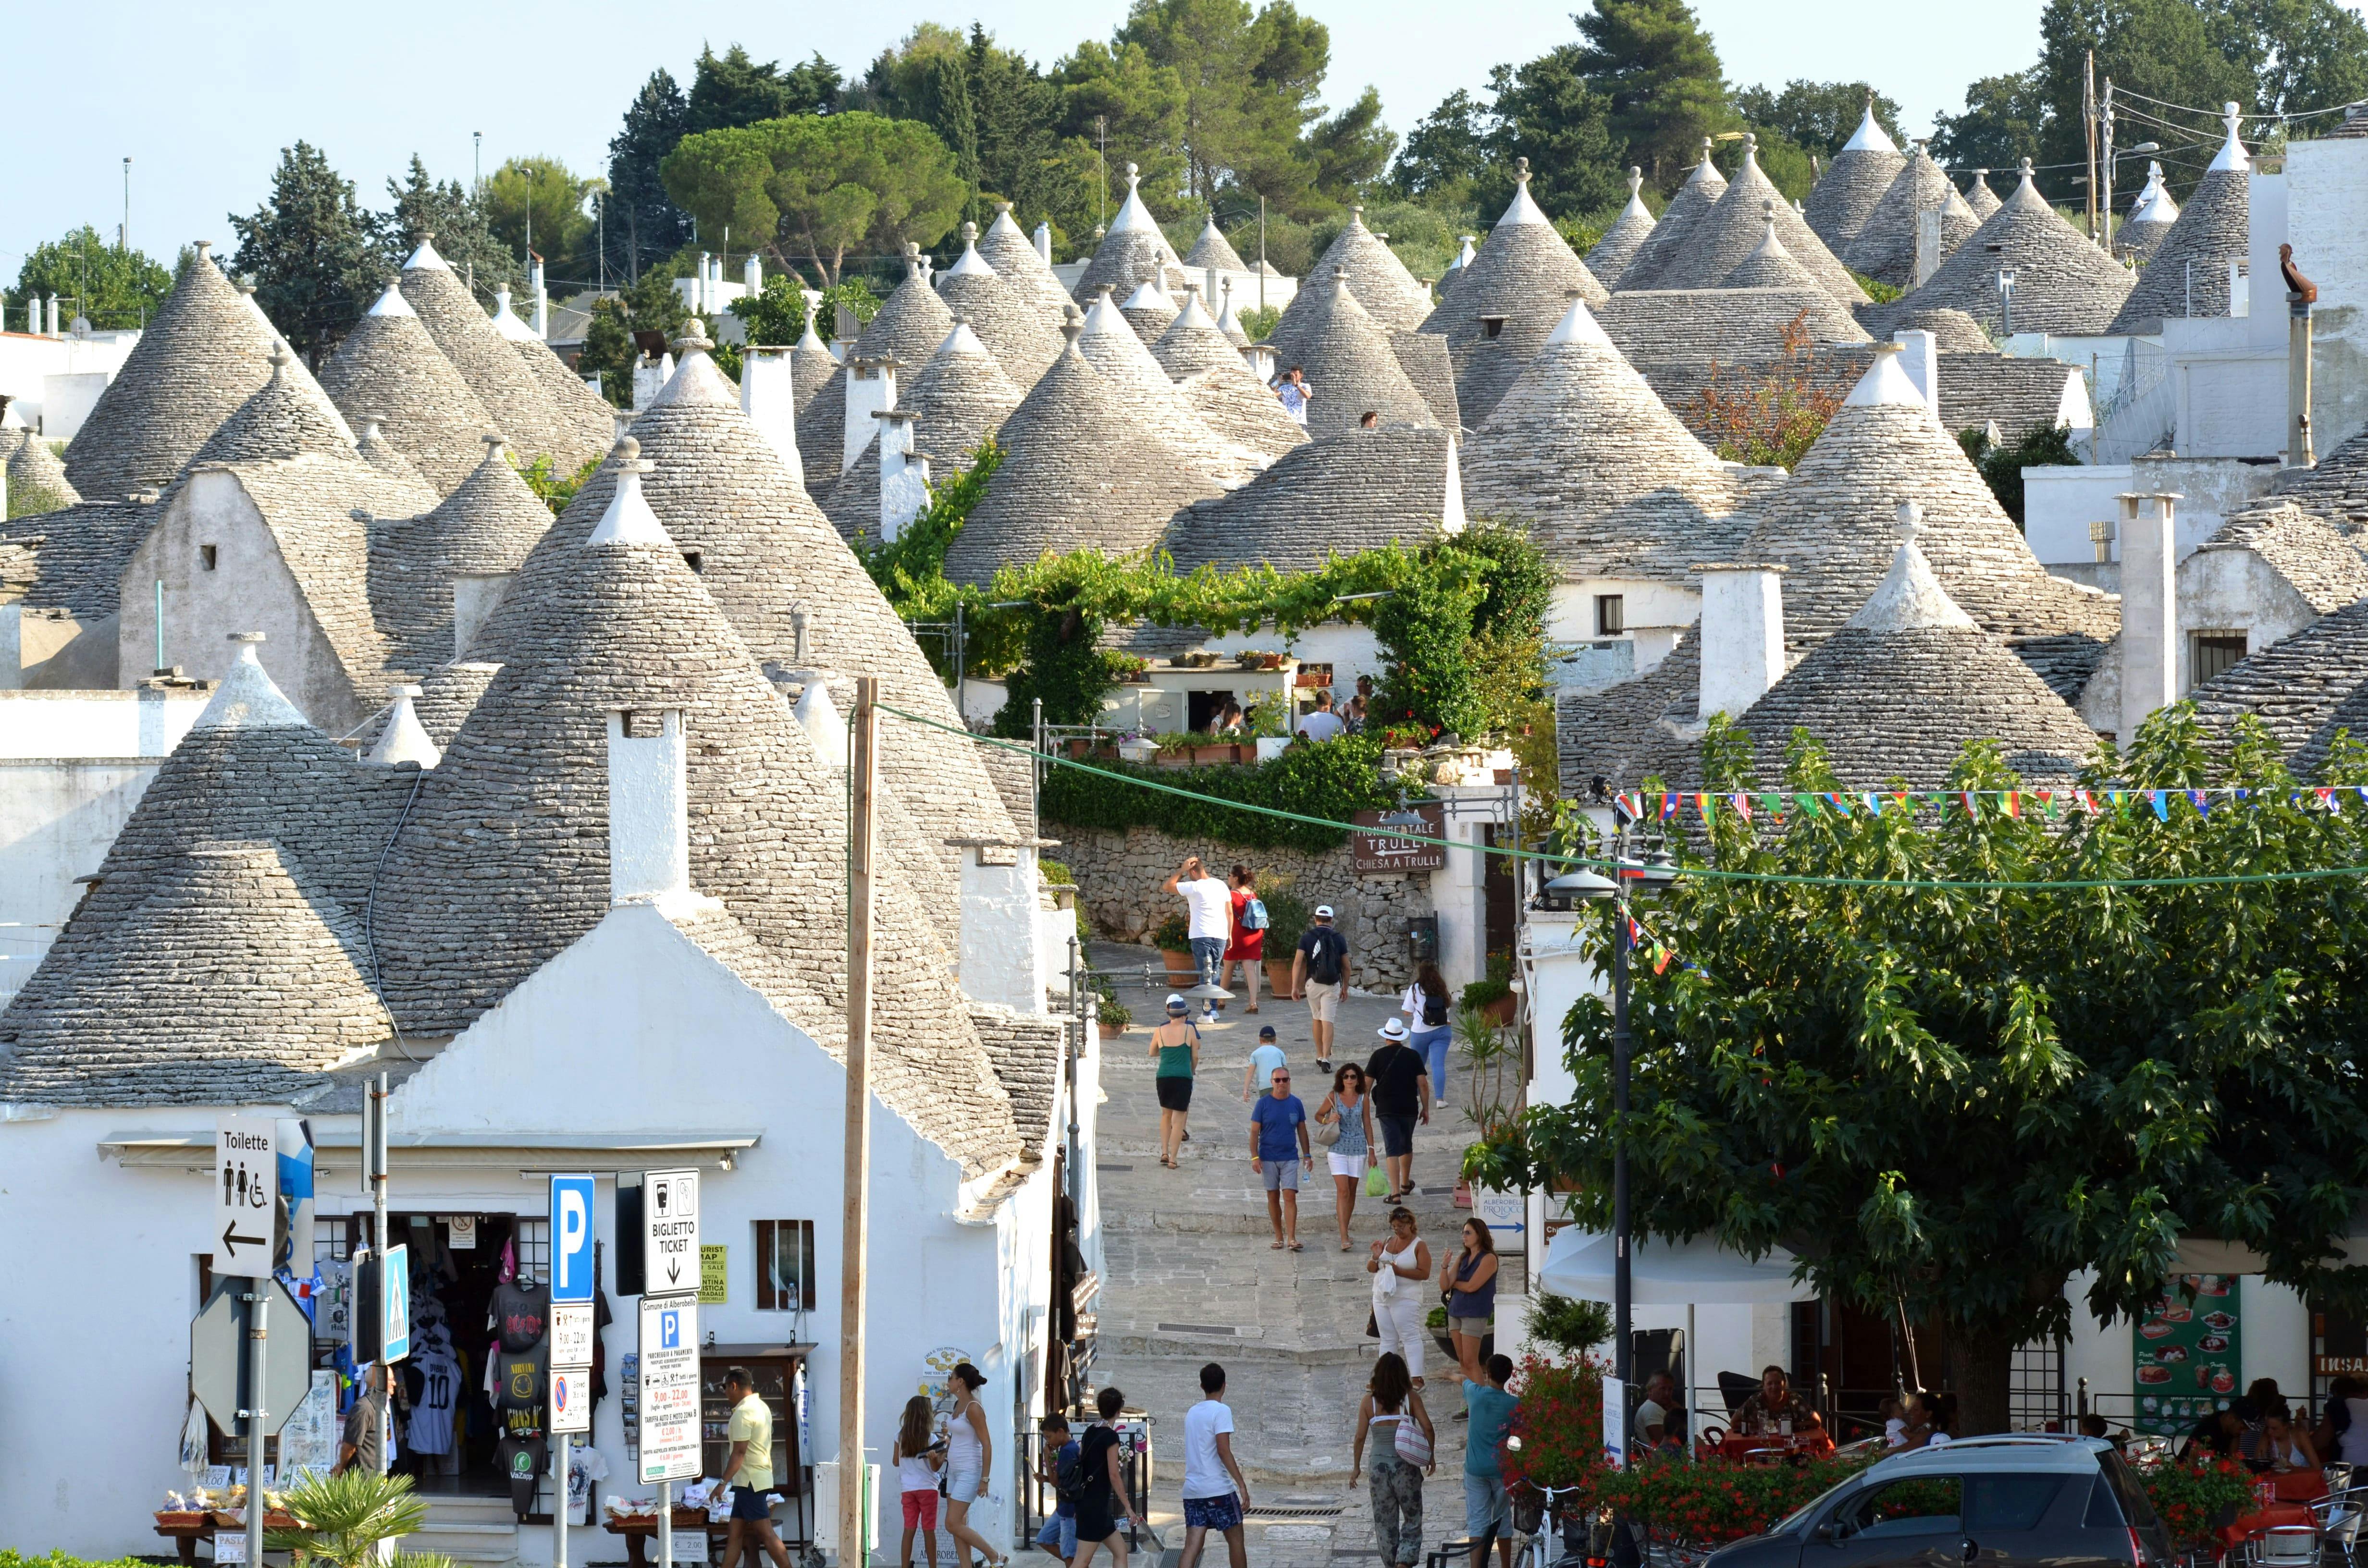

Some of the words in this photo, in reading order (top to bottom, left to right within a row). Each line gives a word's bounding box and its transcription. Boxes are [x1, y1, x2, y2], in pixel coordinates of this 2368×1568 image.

[1378, 809, 1420, 822] ZOA
[1357, 823, 1434, 837] MONUMETALE
[1356, 858, 1390, 870] CHIESA
[1394, 857, 1400, 868] A
[1404, 855, 1439, 867] TRULLI
[224, 1131, 268, 1151] Toilette
[653, 1221, 695, 1237] BIGLIETTO
[560, 1189, 586, 1288] P
[659, 1239, 688, 1253] TICKET
[644, 1303, 663, 1311] Comune
[664, 1300, 668, 1309] di
[669, 1298, 696, 1308] Alberobello
[665, 1315, 676, 1345] P
[648, 1351, 669, 1360] PARCHEGGIO
[674, 1348, 693, 1356] PAGAMENTO
[511, 1363, 534, 1374] NIRVANA
[2320, 1358, 2368, 1372] INSA
[428, 1374, 449, 1410] 10
[654, 1391, 667, 1403] 9,00
[672, 1389, 688, 1400] 22,00
[645, 1415, 659, 1423] TARIFFA
[693, 1409, 697, 1417] B
[510, 1471, 533, 1481] VaZapp
